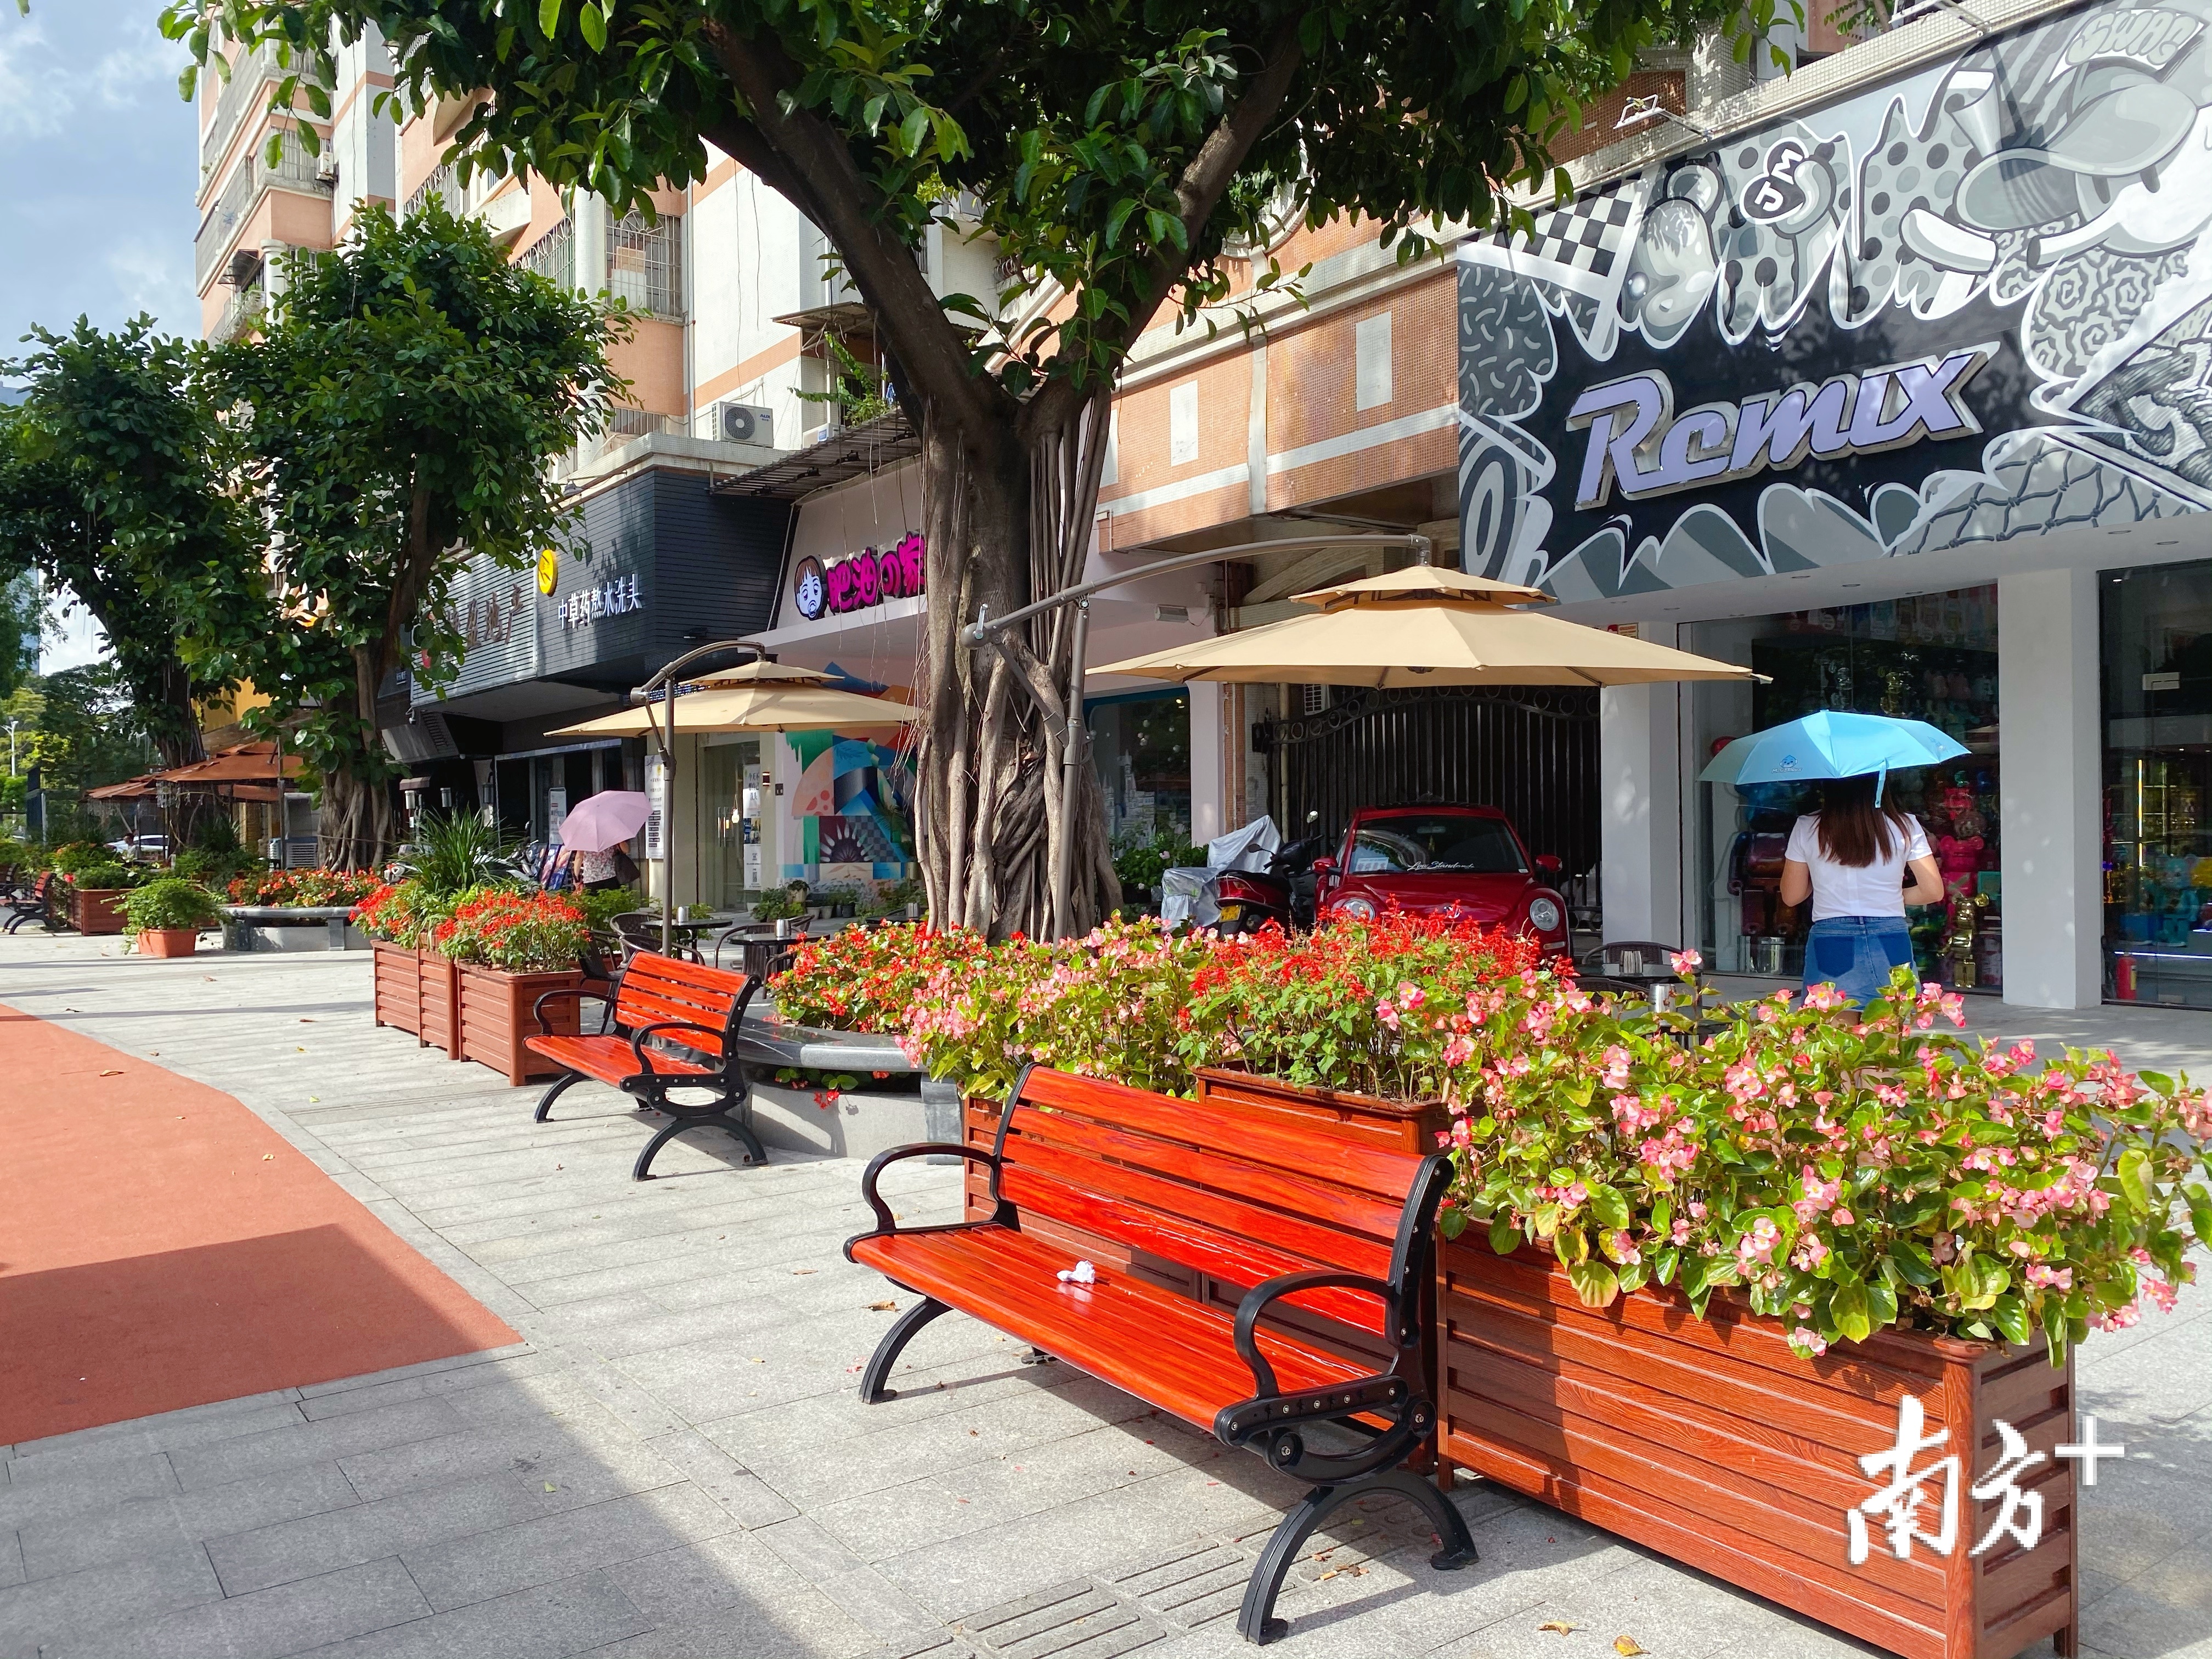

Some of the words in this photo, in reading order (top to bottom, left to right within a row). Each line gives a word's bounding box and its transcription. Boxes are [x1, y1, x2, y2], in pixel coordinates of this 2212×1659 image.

[2065, 8, 2198, 66] SWAG
[1565, 349, 1991, 510] Remix
[558, 573, 642, 630] 中草药熬水洗头
